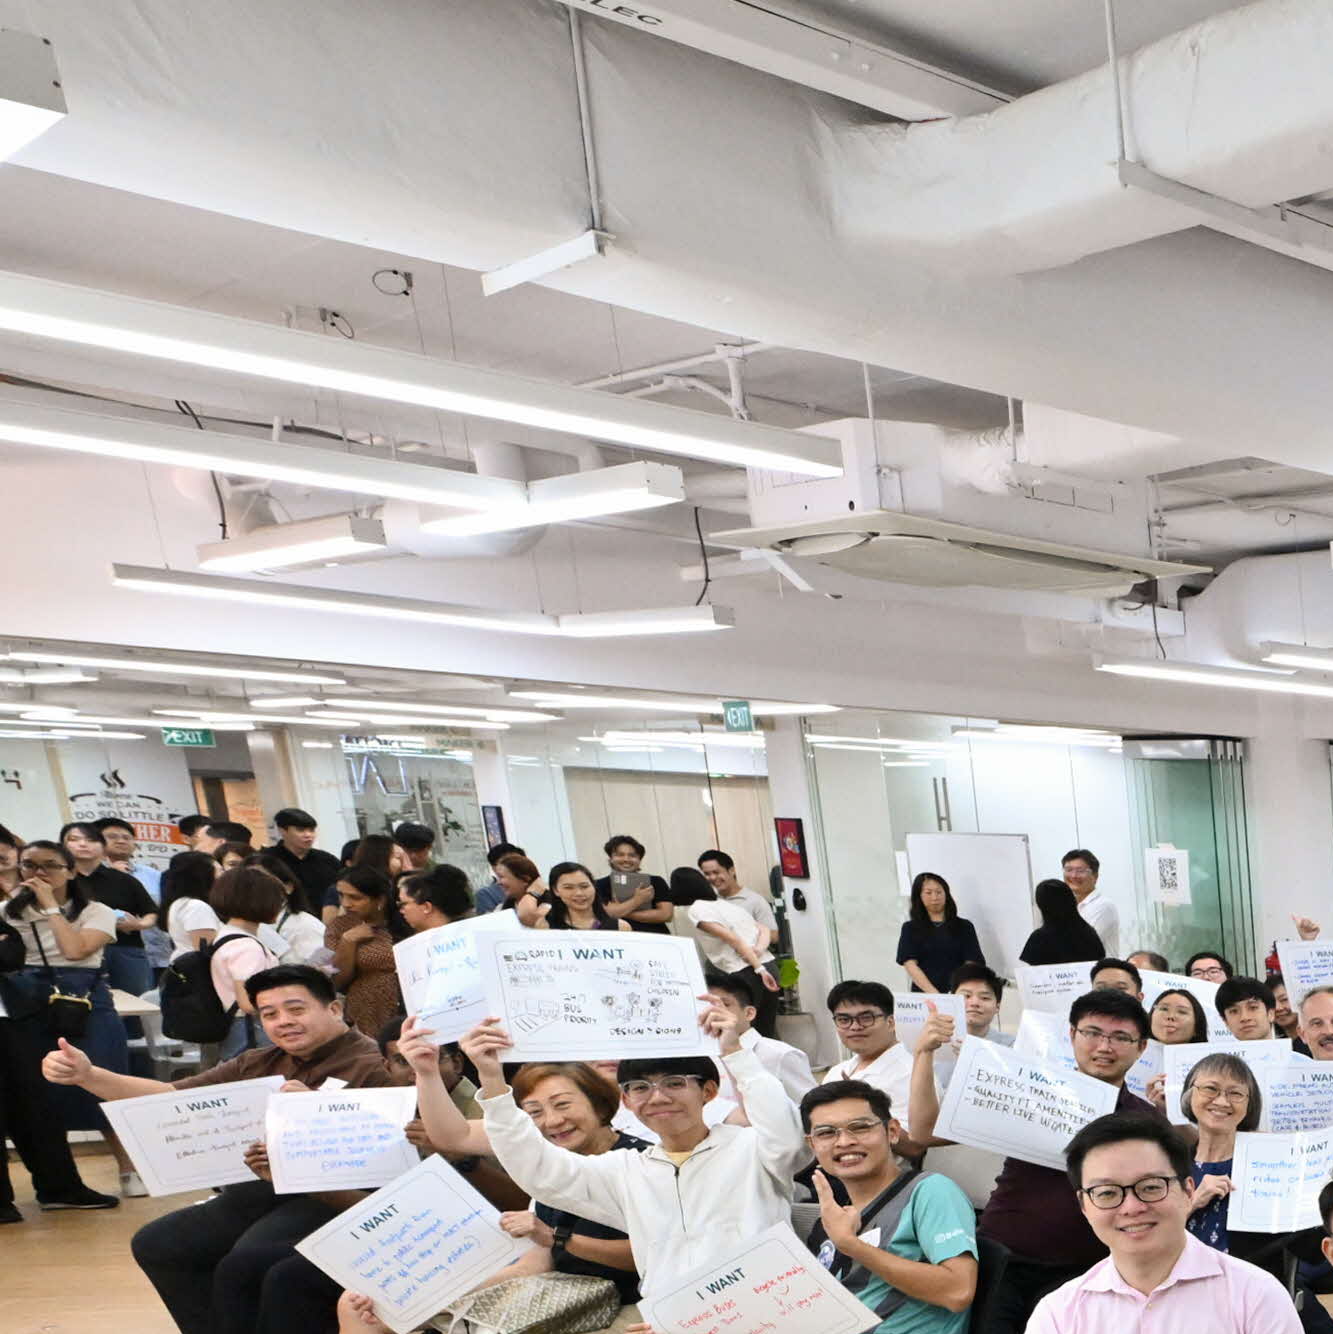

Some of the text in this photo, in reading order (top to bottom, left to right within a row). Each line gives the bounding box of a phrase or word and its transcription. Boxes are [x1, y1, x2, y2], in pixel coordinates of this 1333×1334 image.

[730, 707, 749, 727] EXIT
[174, 730, 203, 744] EXIT
[135, 825, 171, 842] HER
[558, 948, 624, 961] I WANT
[1018, 1067, 1023, 1077] I
[1302, 1074, 1305, 1082] I
[976, 1068, 1057, 1101] EXPRESS TRAIN
[974, 1085, 1015, 1104] QUALITY
[174, 1097, 229, 1114] I WANT
[318, 1102, 361, 1113] I WANT
[972, 1098, 1034, 1122] BETTER LIVE
[1290, 1141, 1328, 1155] I WANT
[350, 1204, 400, 1240] I WANT
[696, 1267, 746, 1300] I WANT
